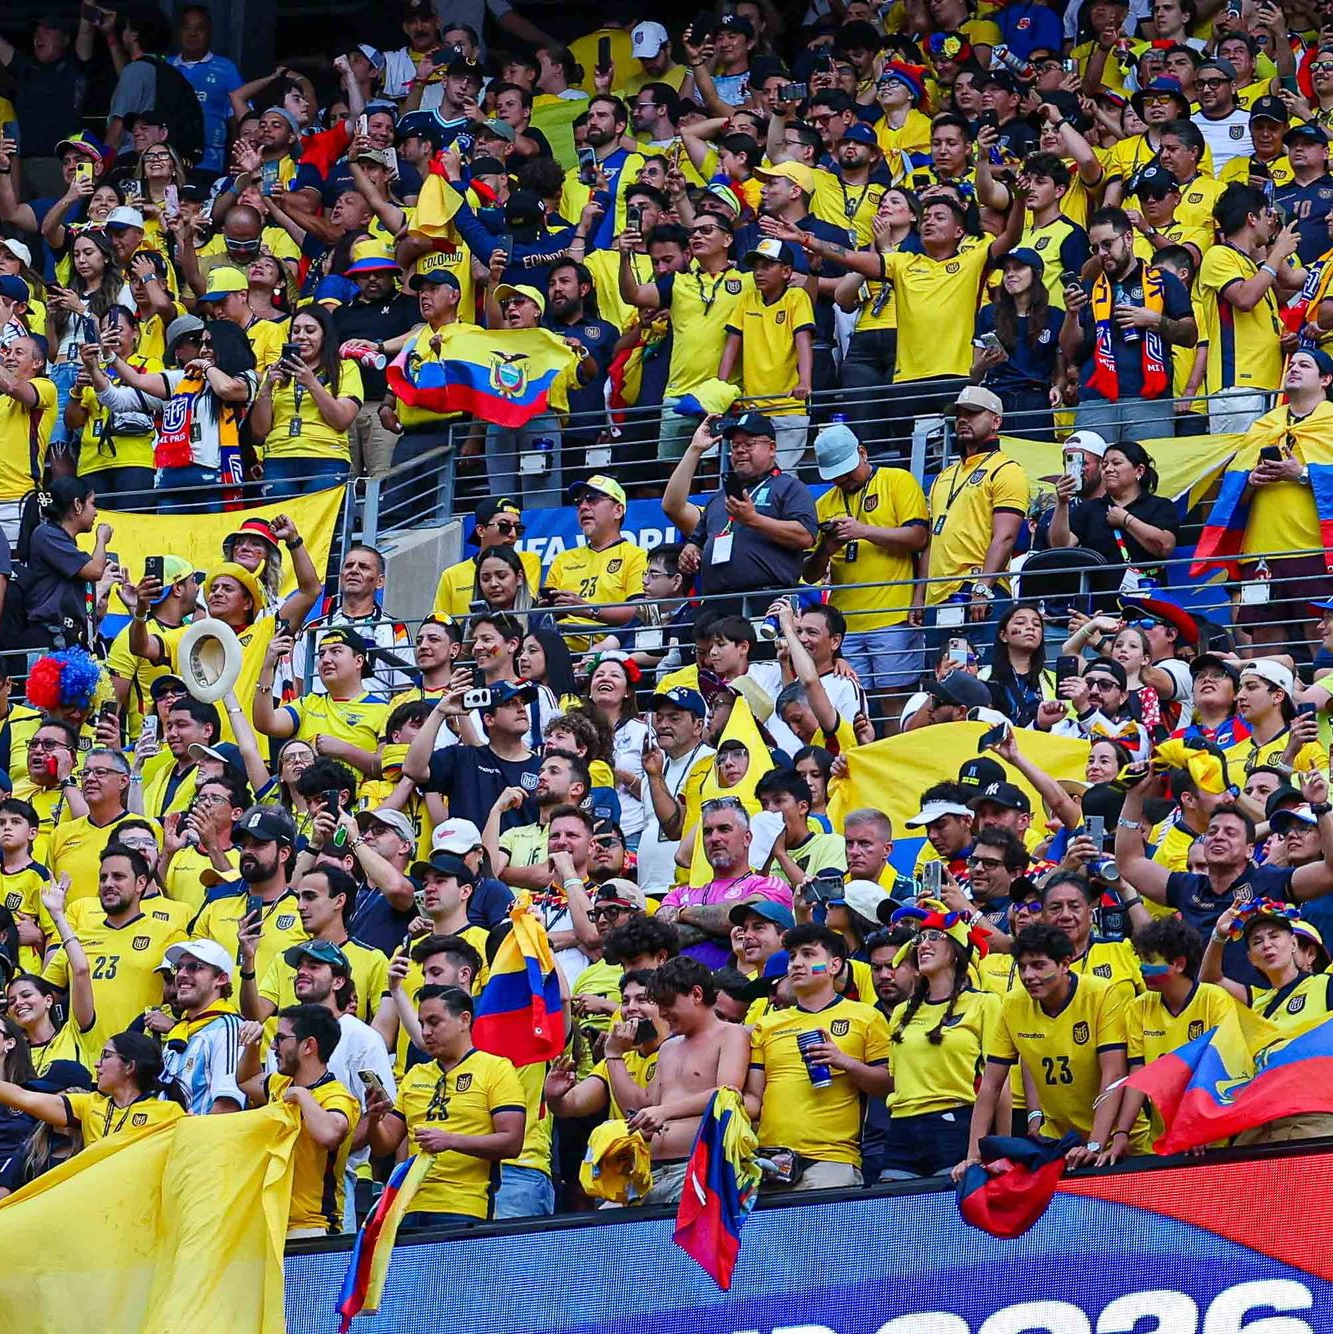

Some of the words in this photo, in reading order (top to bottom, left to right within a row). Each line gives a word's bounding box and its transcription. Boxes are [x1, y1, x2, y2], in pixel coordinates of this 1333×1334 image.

[579, 576, 599, 598] 23
[985, 782, 1000, 796] NY
[92, 955, 121, 980] 23
[1017, 1031, 1045, 1040] marathon
[1041, 1055, 1073, 1086] 23
